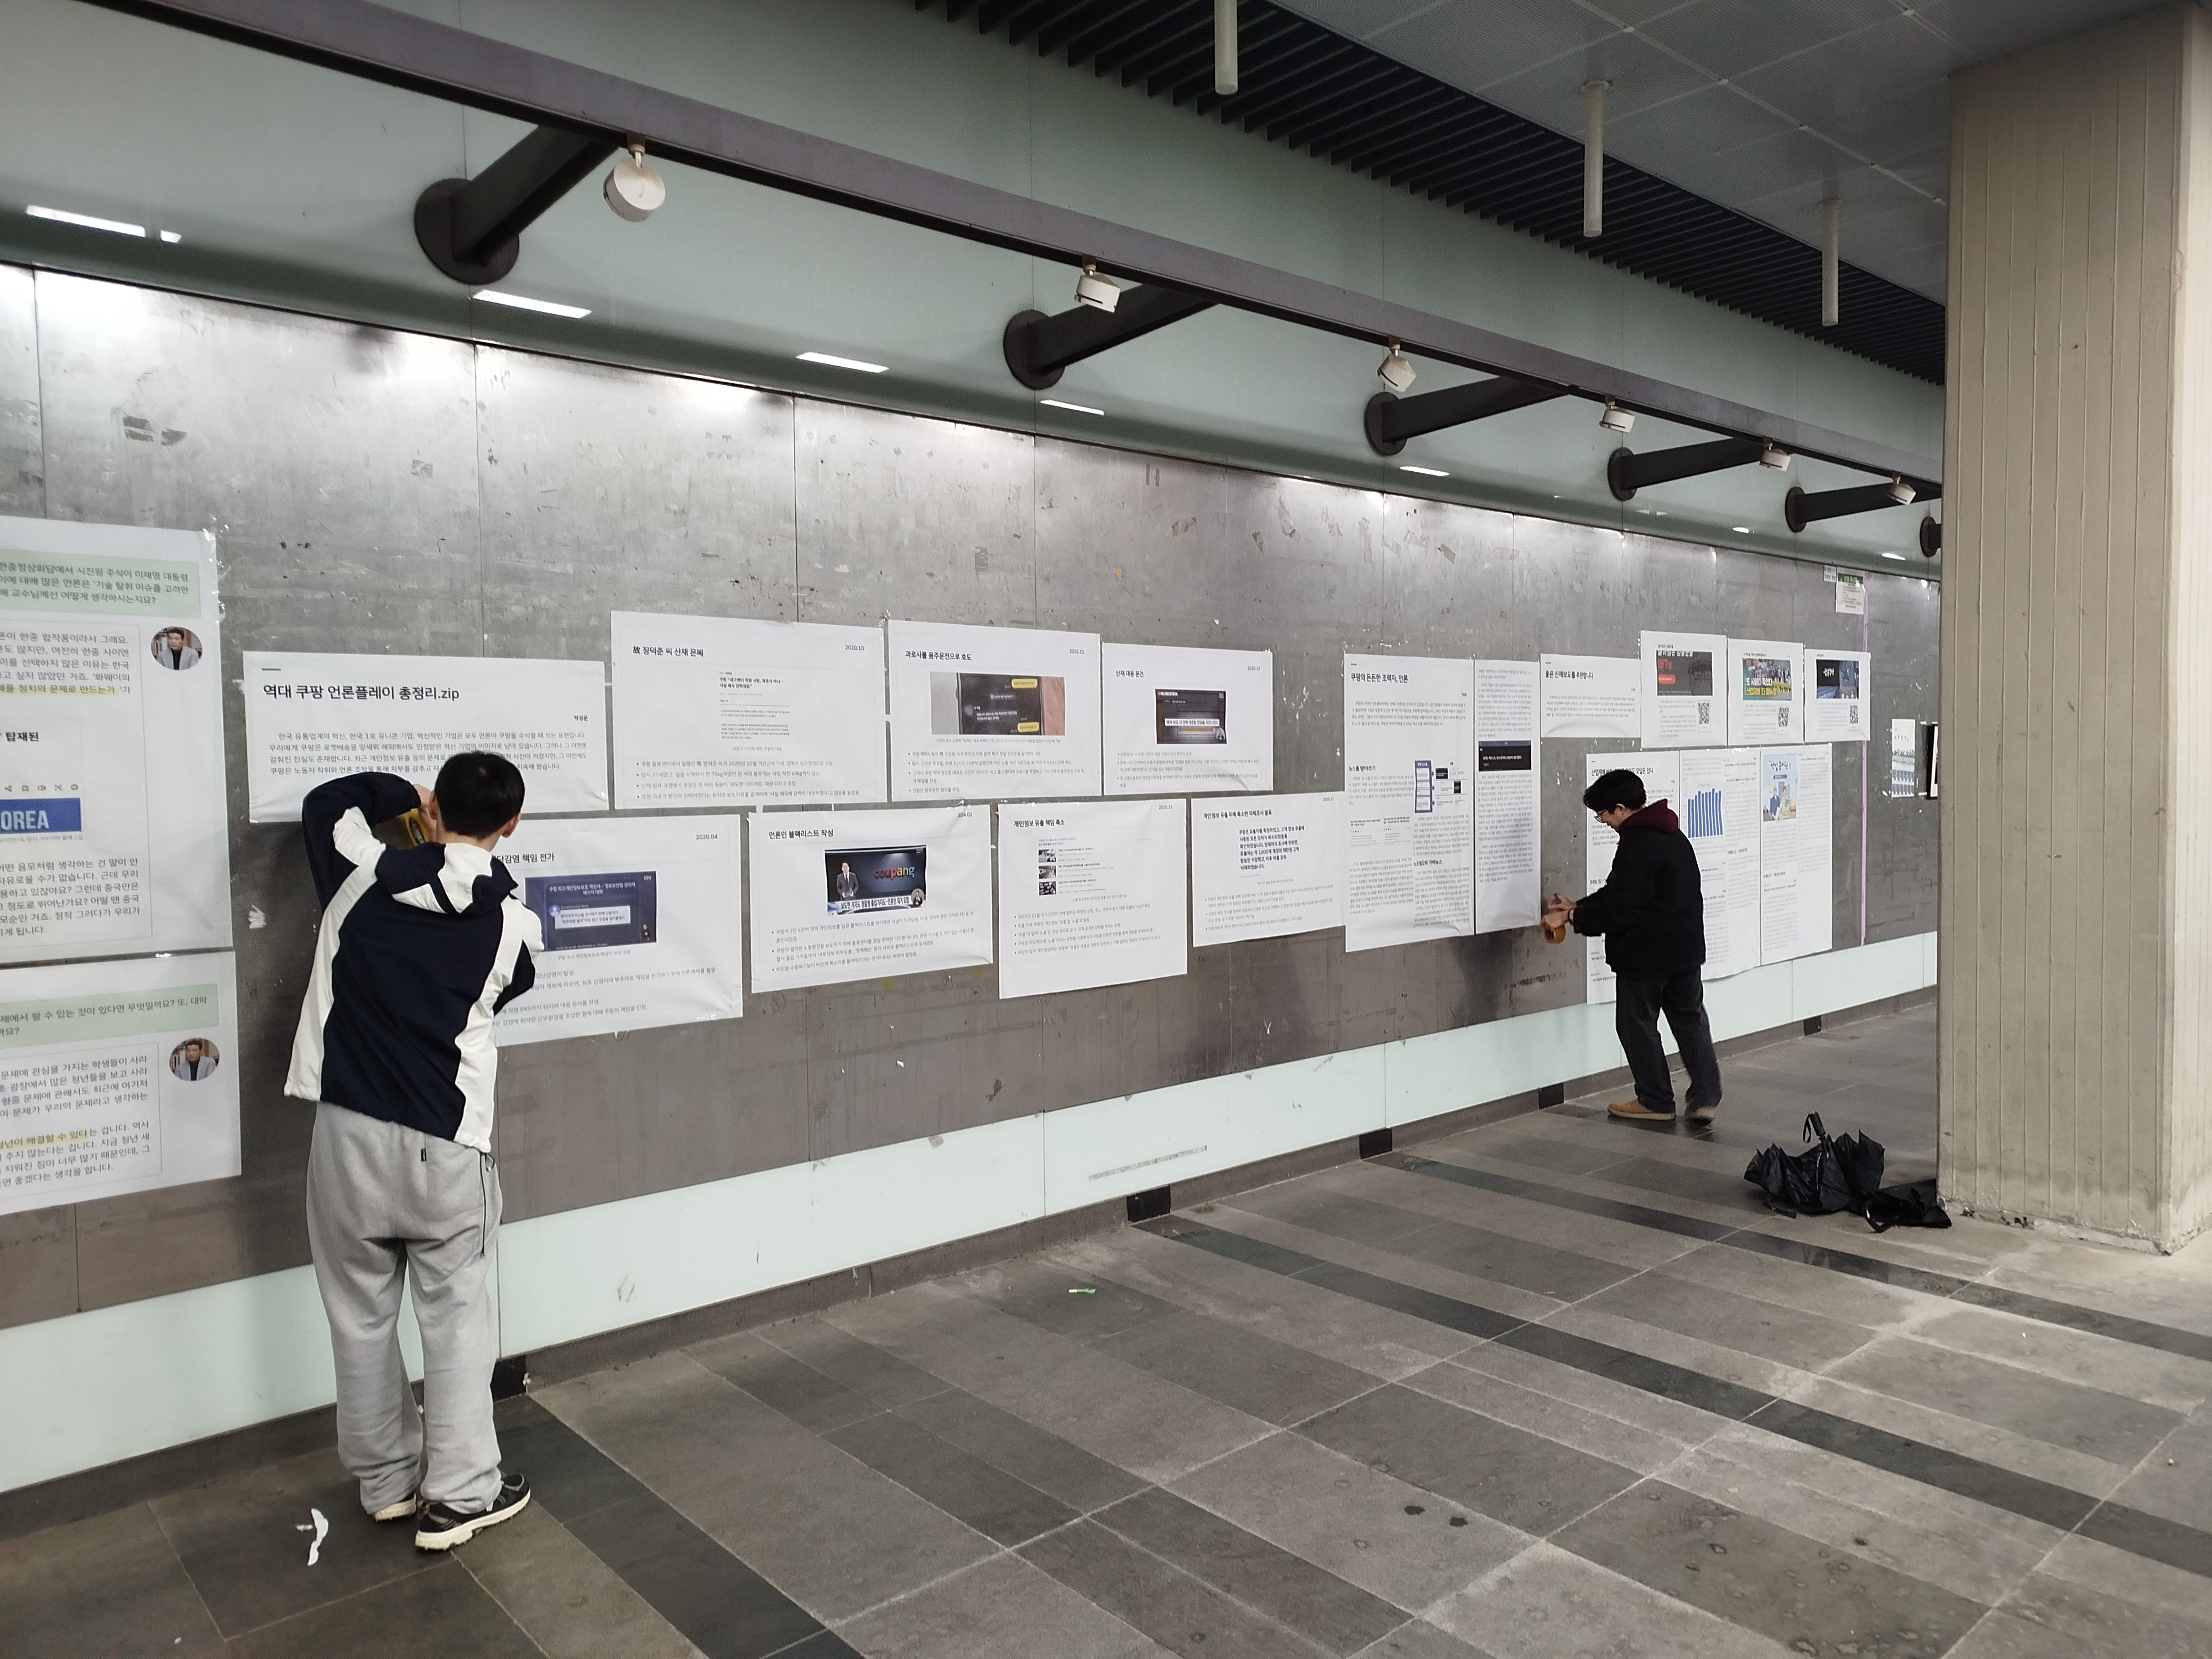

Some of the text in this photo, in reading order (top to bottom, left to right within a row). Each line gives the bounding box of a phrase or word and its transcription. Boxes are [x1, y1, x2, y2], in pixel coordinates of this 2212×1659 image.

[76, 567, 103, 576] 시진핑
[106, 569, 133, 578] 주석이
[135, 571, 160, 580] 이재명
[163, 573, 188, 582] 대통령
[643, 647, 664, 655] 장덕준
[1351, 672, 1408, 683] 쿠팡의 든든한 조력자, 언론
[263, 685, 459, 700] 역대 쿠팡 언론플레이 총정리.zip
[6, 732, 39, 741] 탑재된
[0, 811, 49, 830] OREA
[789, 830, 820, 838] 블랙리스트
[522, 854, 537, 863] 책임
[540, 853, 555, 862] 전가
[38, 874, 55, 883] 수가
[59, 873, 97, 881] 없습니다.
[101, 871, 118, 880] 근데
[122, 870, 138, 879] 우리
[874, 866, 915, 879] coupang
[0, 1014, 29, 1022] 제에서
[32, 1013, 41, 1021] 할
[56, 1010, 74, 1018] 있는
[77, 1007, 95, 1016] 것이
[98, 1005, 125, 1014] 있다면
[127, 1000, 175, 1011] 무엇일까요?
[190, 996, 207, 1004] 대학
[1, 1055, 149, 1079] 문제에 관심을 가지는 학생들이 사라
[6, 1150, 23, 1160] 주지
[28, 1146, 64, 1157] 않는다는
[69, 1141, 97, 1152] 겁니다.
[101, 1138, 117, 1146] 지금
[122, 1135, 138, 1144] 청년
